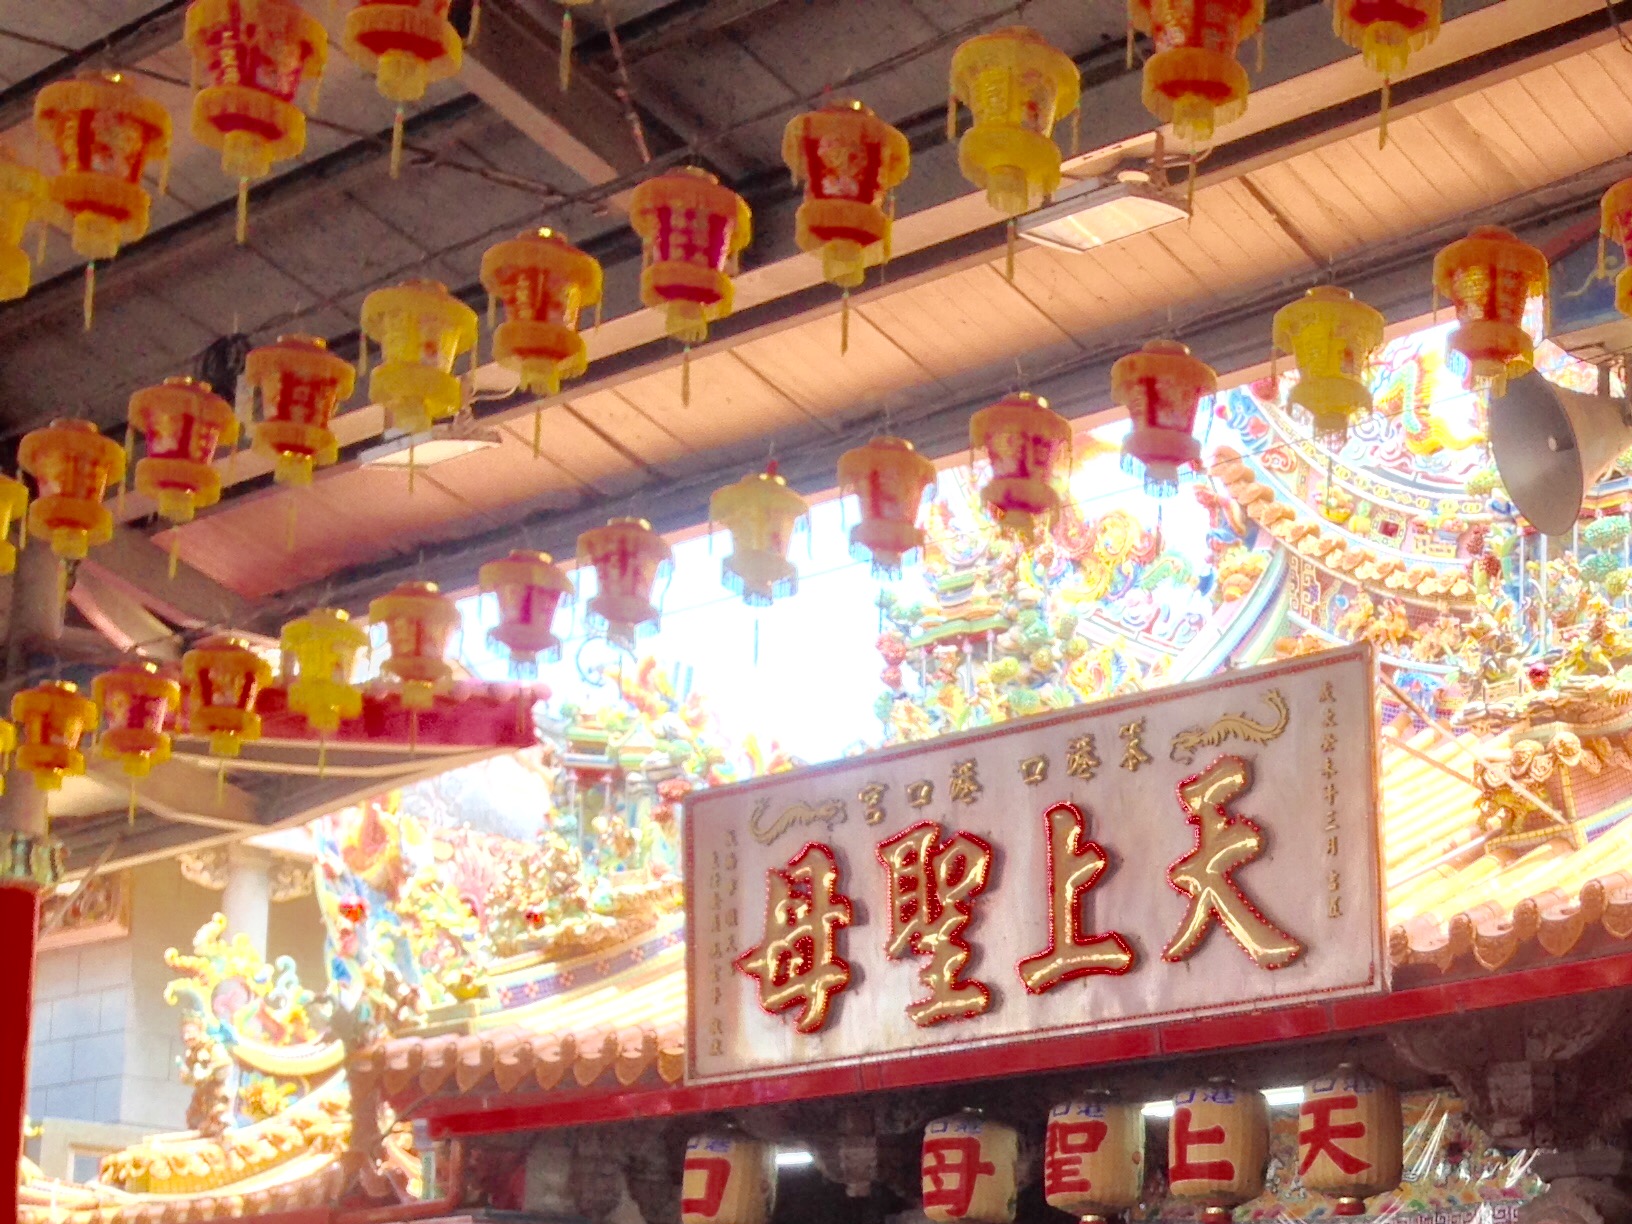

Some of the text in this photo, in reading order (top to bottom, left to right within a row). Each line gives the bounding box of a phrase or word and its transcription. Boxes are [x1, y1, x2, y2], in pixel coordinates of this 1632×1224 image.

[857, 757, 985, 826] 港口宮
[734, 753, 1304, 1035] 天上聖母
[1169, 1107, 1235, 1183] 上
[1299, 1094, 1373, 1176] 天
[922, 1136, 996, 1218] 母
